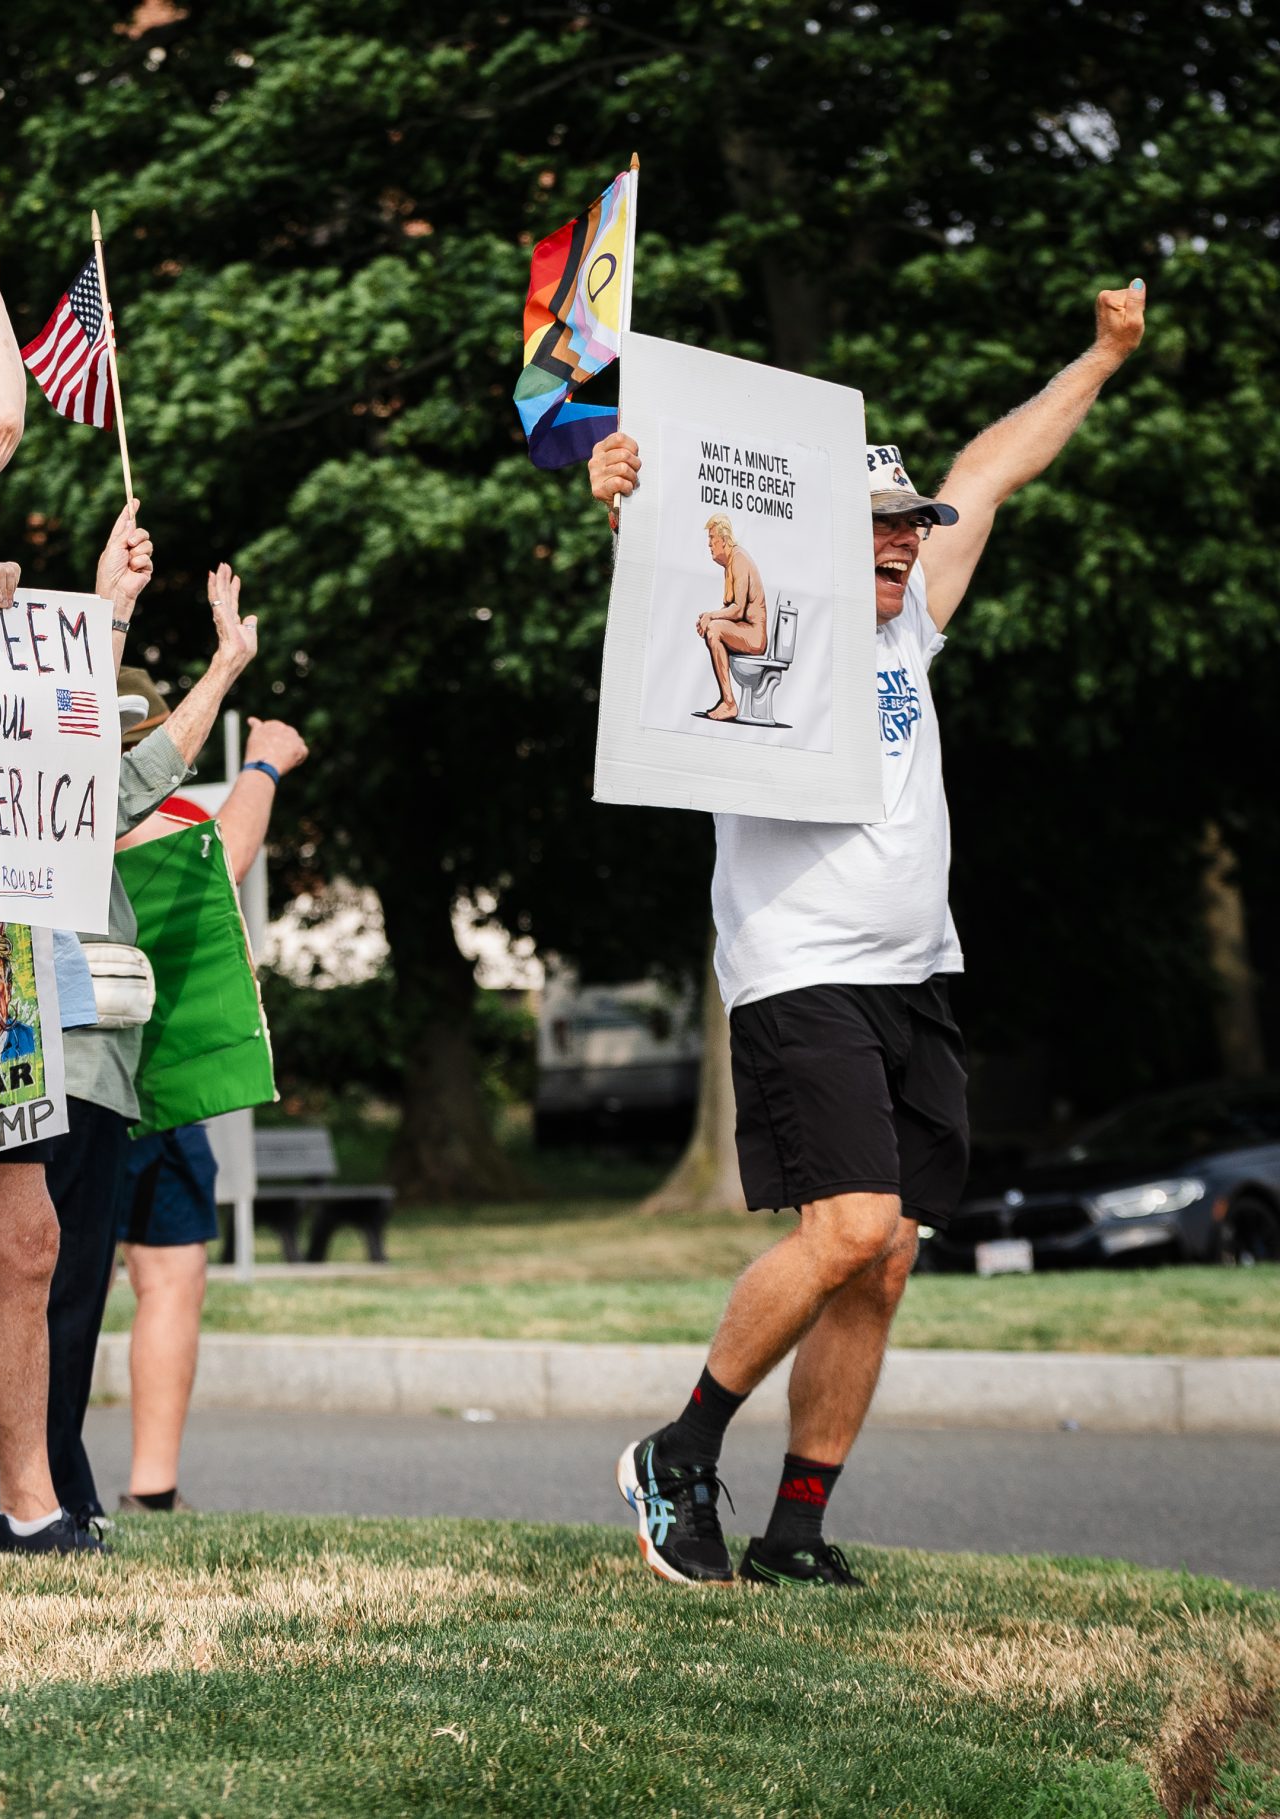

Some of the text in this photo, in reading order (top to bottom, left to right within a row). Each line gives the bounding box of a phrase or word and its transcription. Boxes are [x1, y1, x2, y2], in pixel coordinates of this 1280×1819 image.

[701, 441, 792, 478] WAIT A MINUTE,
[698, 463, 796, 498] ANOTHER GREAT
[701, 485, 793, 520] IDEA IS COMING
